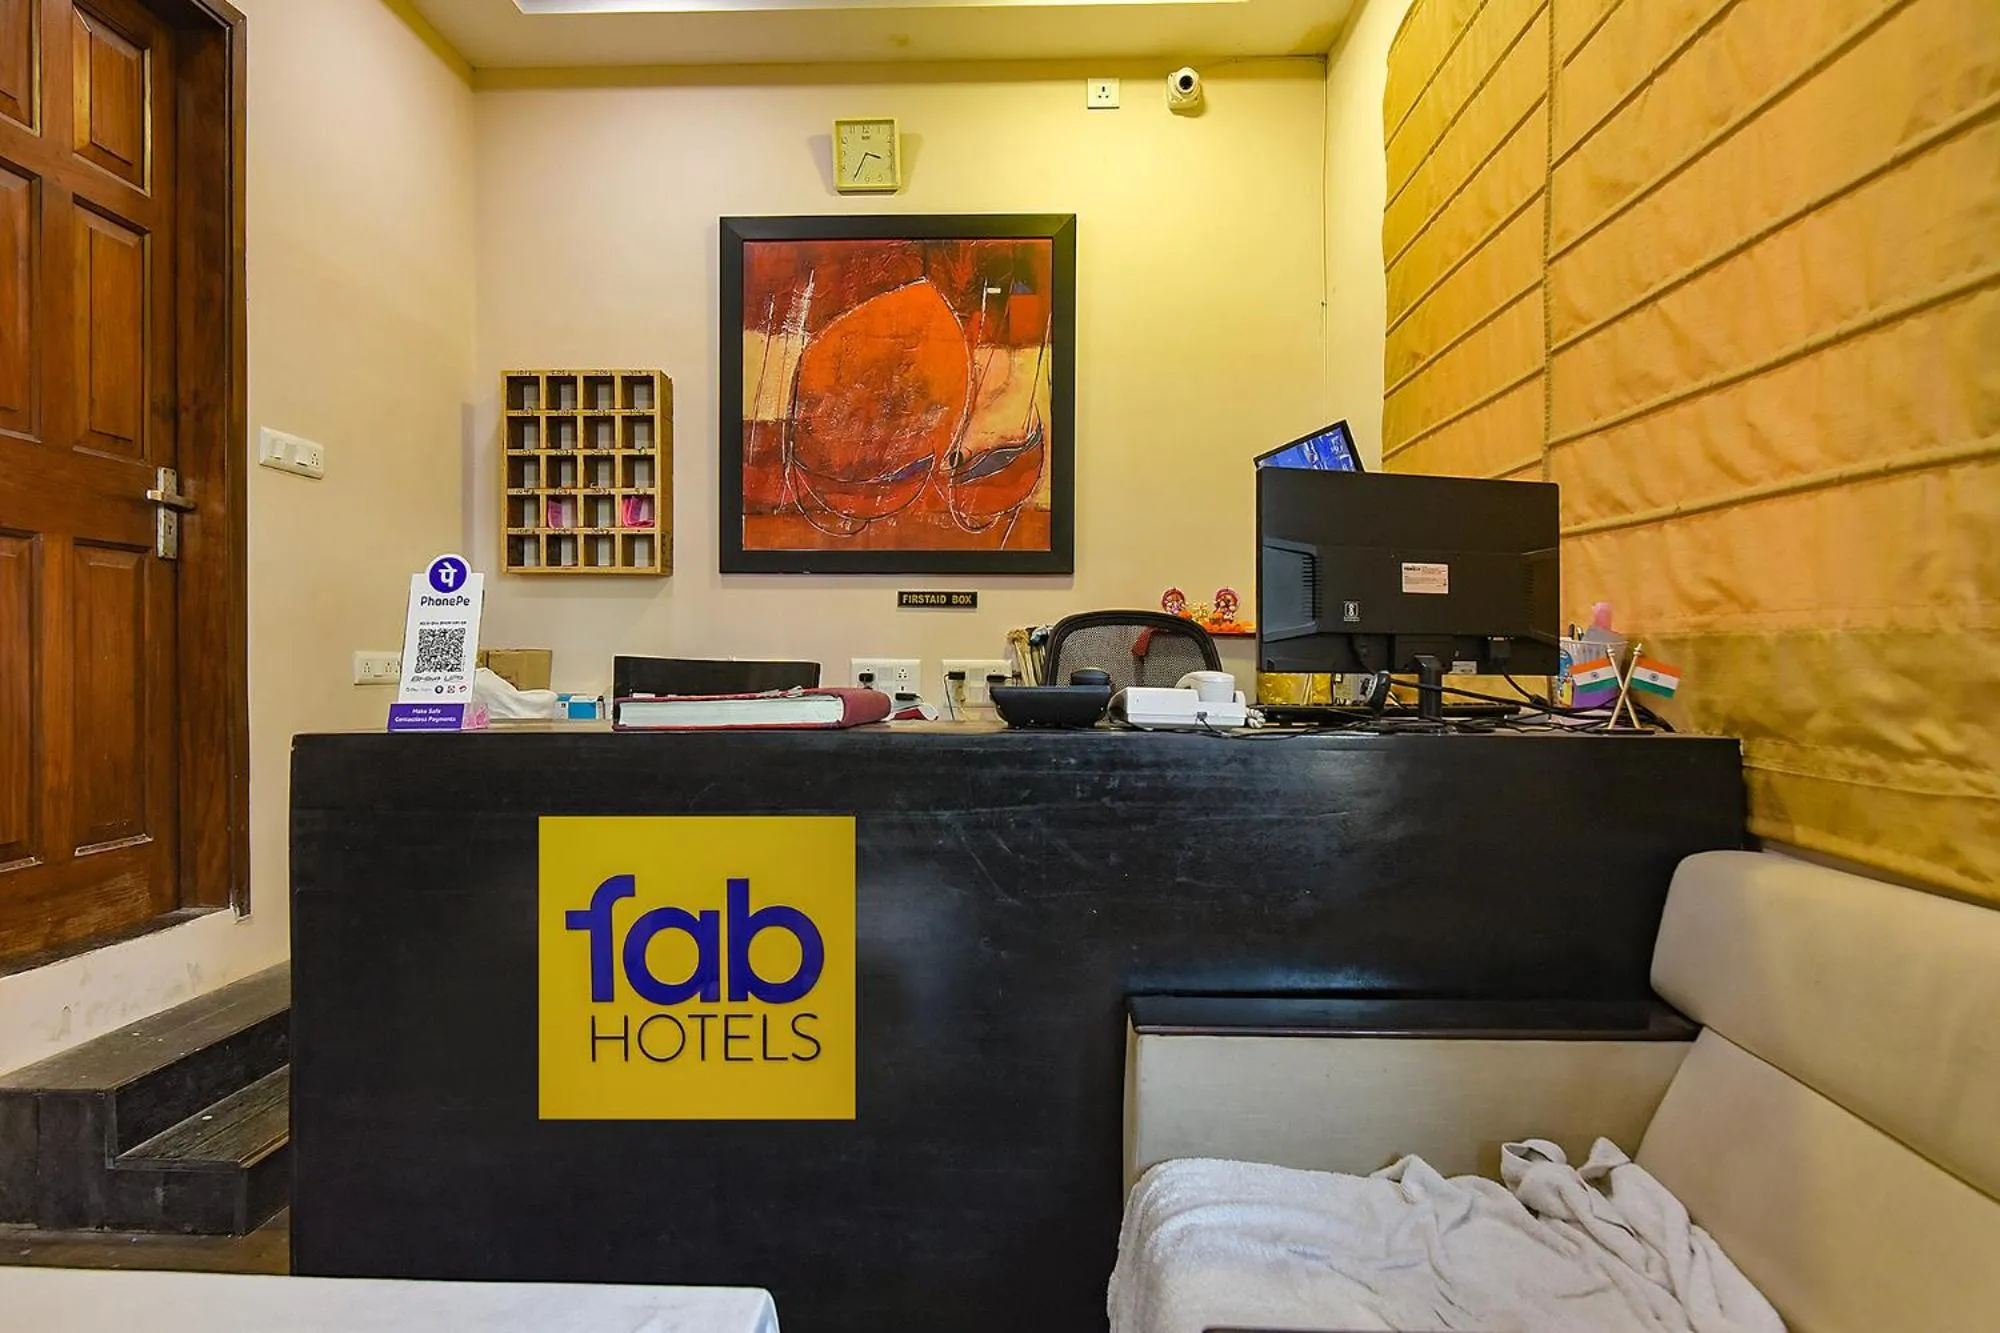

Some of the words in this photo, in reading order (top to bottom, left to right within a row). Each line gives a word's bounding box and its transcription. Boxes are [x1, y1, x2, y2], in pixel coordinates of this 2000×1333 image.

[420, 595, 471, 607] PhonePe
[902, 594, 947, 605] FIRSTAID
[951, 594, 972, 605] BOX
[565, 874, 825, 1006] fab
[591, 1013, 822, 1063] HOTELS
